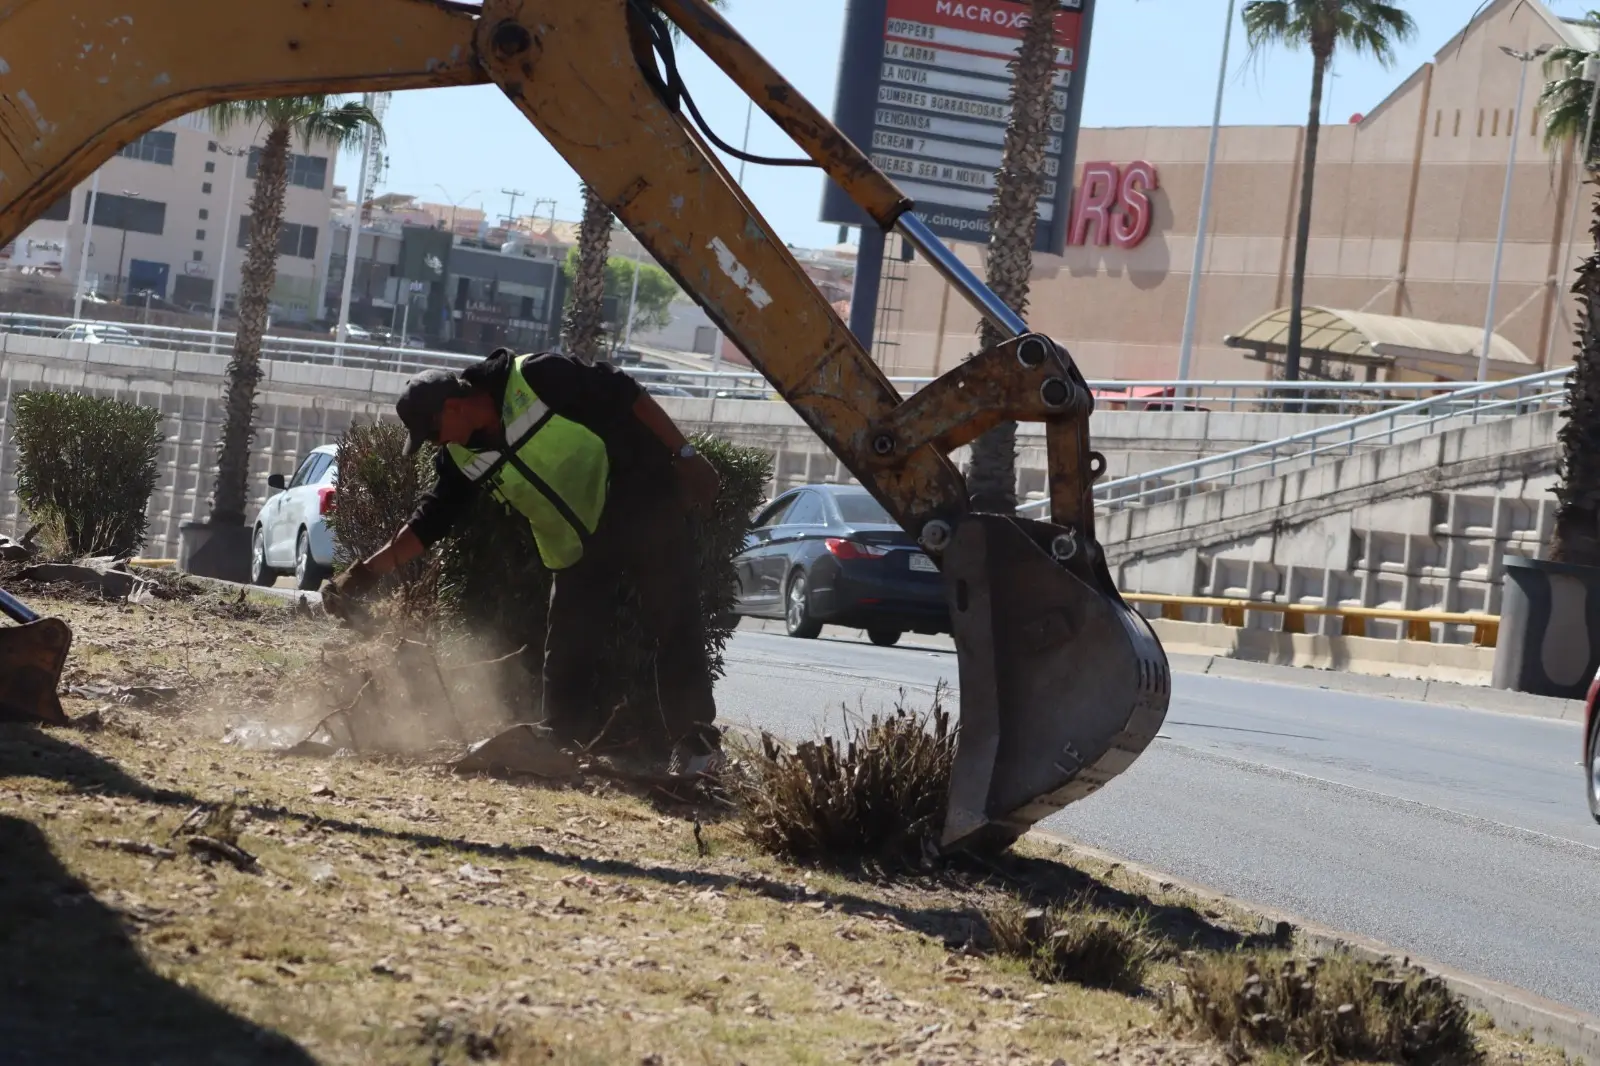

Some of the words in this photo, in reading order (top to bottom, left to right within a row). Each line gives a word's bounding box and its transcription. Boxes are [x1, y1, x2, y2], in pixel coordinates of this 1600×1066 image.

[887, 20, 935, 39] HOPPERS
[885, 43, 898, 56] LA
[902, 45, 935, 62] CABRA
[881, 66, 894, 78] LA
[897, 68, 927, 84] NOVIA
[879, 87, 926, 107] CUMBRES
[877, 110, 931, 129] VENGANSA
[874, 132, 914, 149] SCREAM
[918, 139, 926, 152] 7
[918, 163, 938, 177] SER
[942, 166, 953, 179] MI
[956, 170, 986, 185] NOVIA
